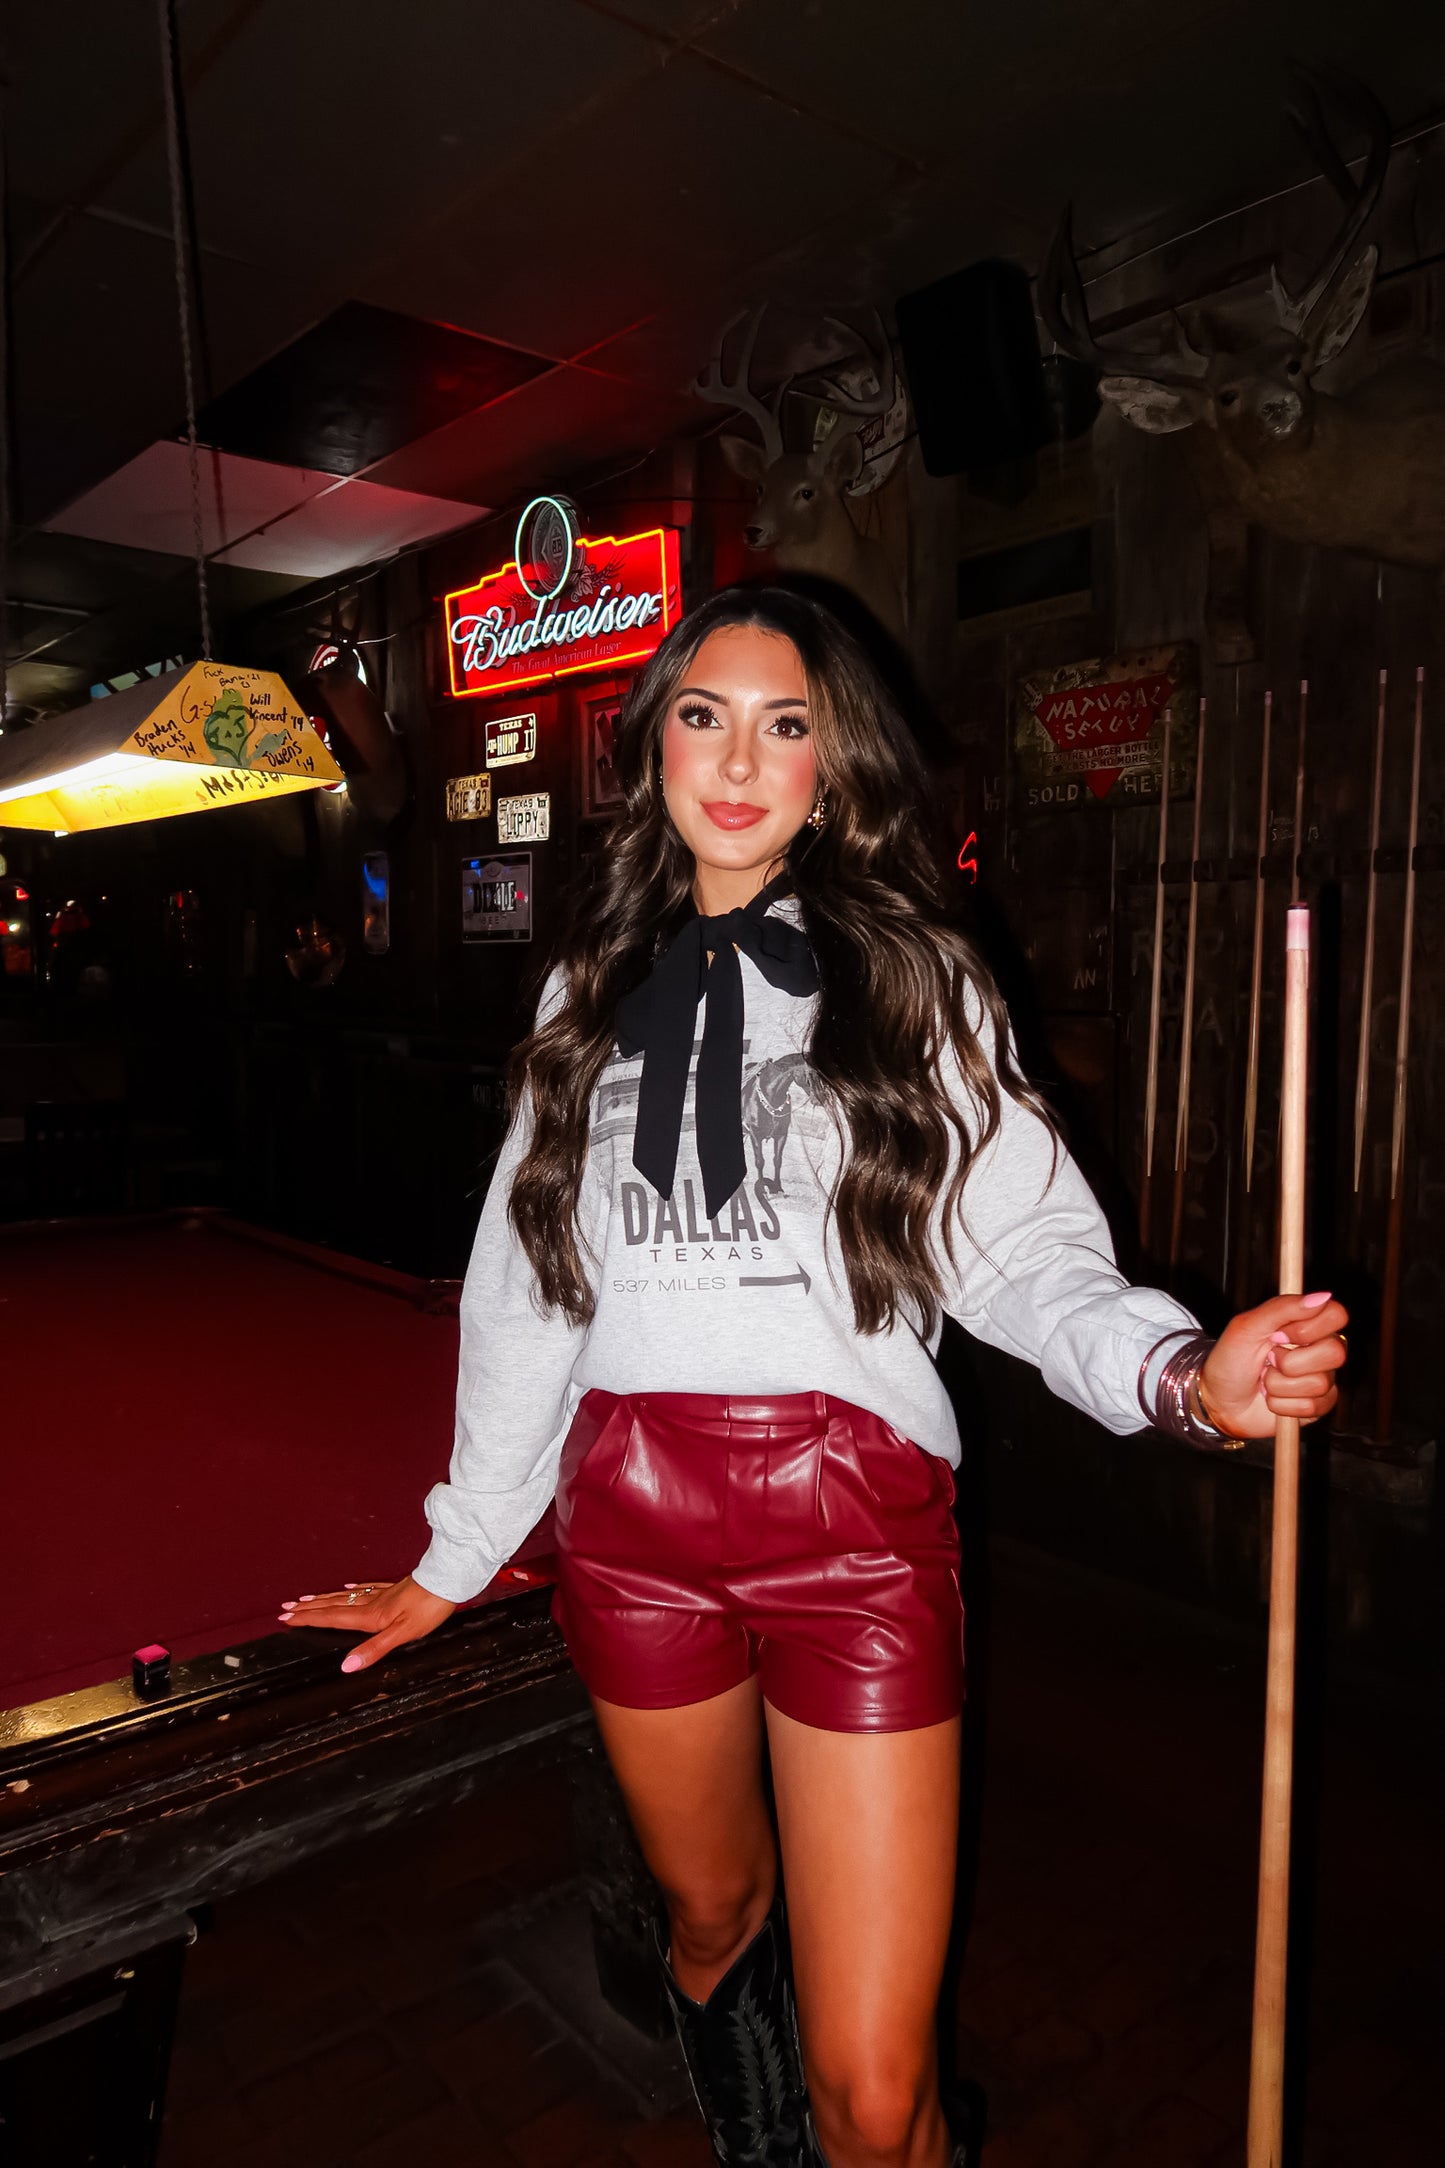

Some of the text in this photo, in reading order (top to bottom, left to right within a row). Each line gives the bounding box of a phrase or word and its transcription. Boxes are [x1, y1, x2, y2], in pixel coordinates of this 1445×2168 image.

[452, 583, 665, 672] Budweiser
[250, 693, 271, 706] Will
[1045, 685, 1162, 723] NATURAL
[249, 707, 288, 724] Vincent
[134, 719, 178, 748] Braden
[147, 730, 187, 756] Hucks
[1087, 745, 1122, 759] LARGER
[1118, 753, 1146, 764] MORE
[459, 777, 477, 790] TEXAS
[511, 797, 534, 809] TEXAS
[1028, 783, 1079, 806] SOLD
[621, 1177, 781, 1246] DALLAS
[649, 1246, 764, 1264] TEXAS
[613, 1276, 727, 1293] 537 MILES
